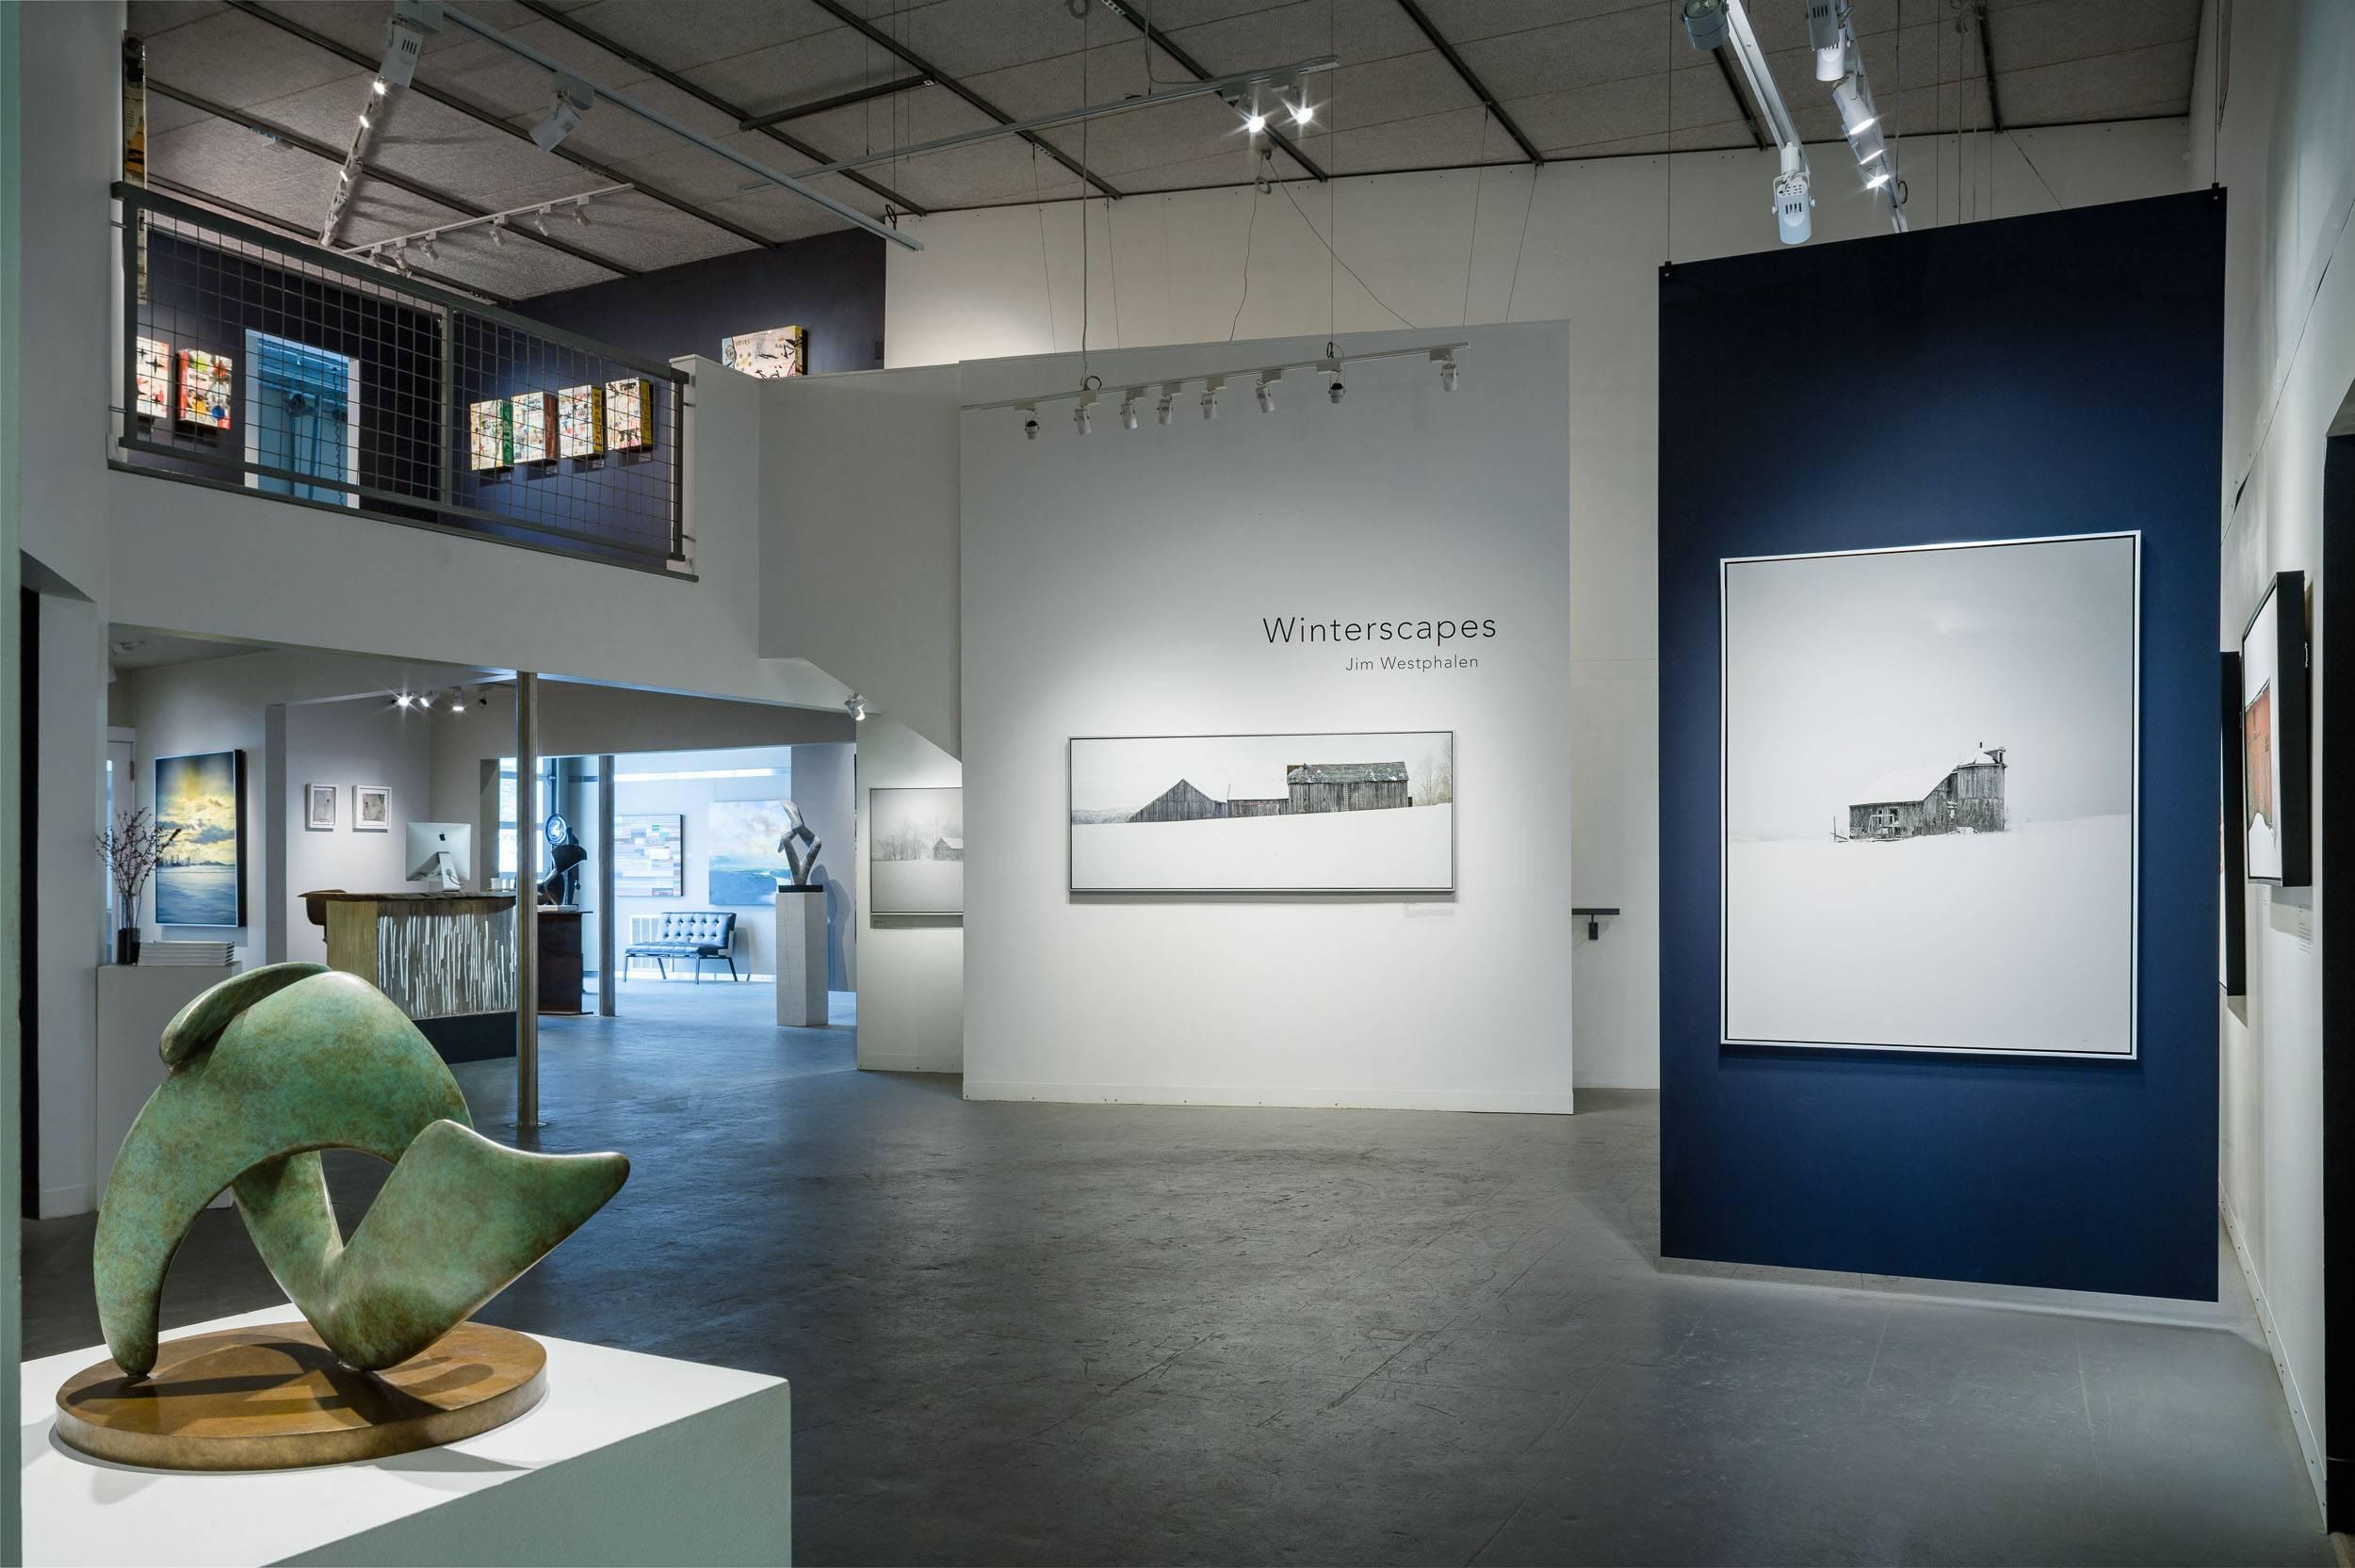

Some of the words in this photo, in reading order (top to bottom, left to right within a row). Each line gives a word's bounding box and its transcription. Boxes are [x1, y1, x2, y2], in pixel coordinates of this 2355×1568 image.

[1262, 616, 1497, 646] Winterscapes
[1345, 656, 1374, 671] Jim
[1380, 654, 1478, 672] Westphalen
